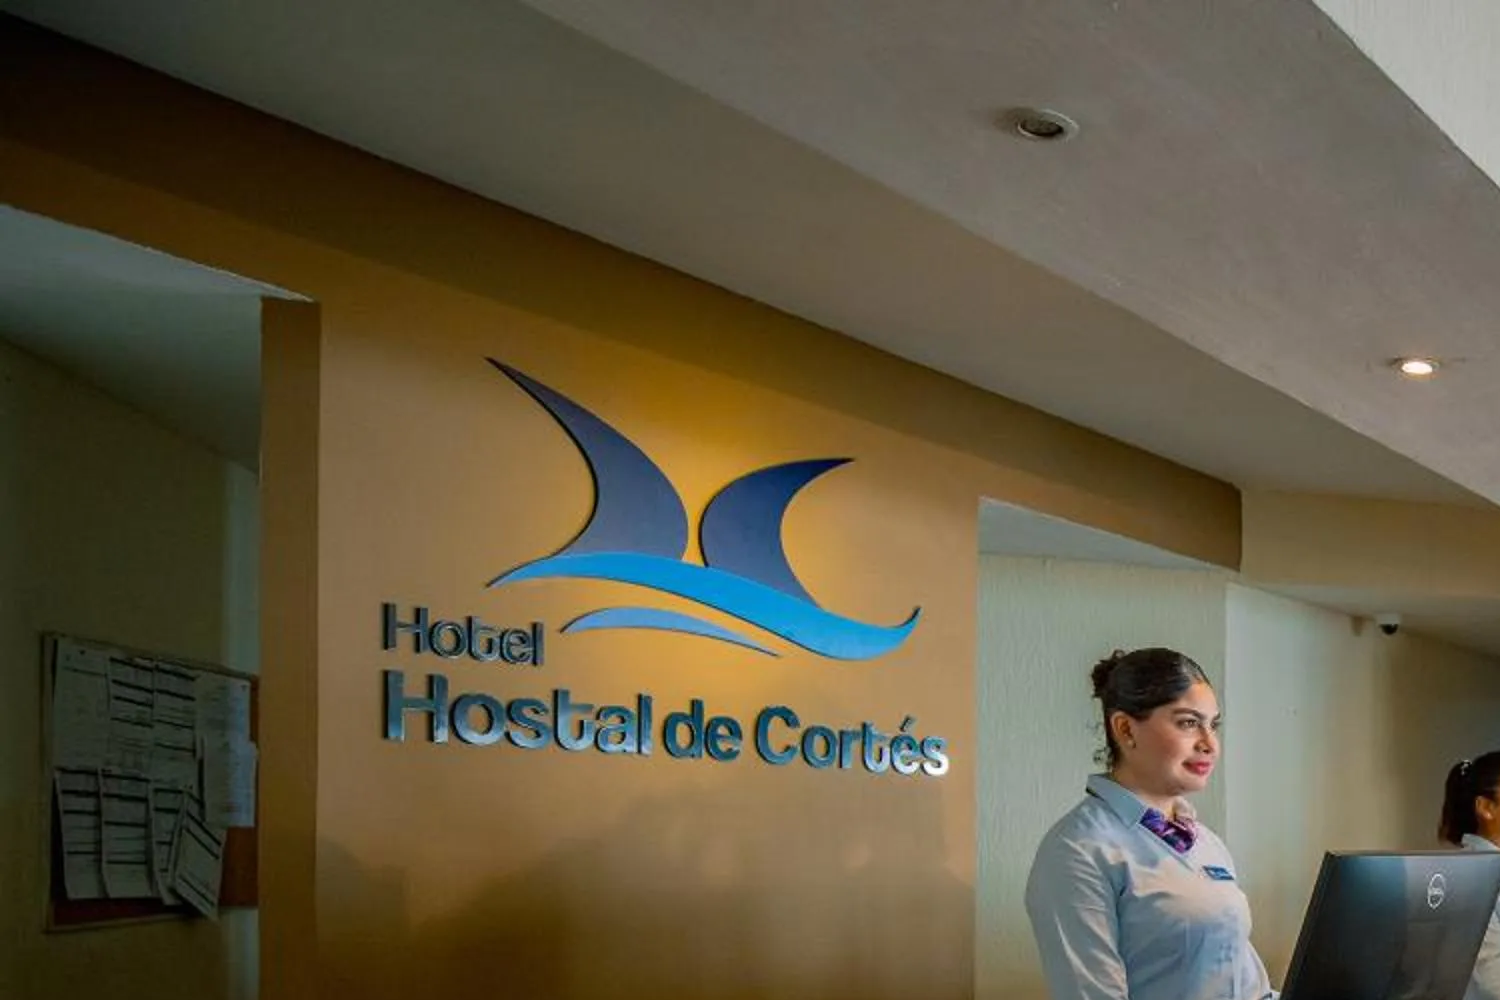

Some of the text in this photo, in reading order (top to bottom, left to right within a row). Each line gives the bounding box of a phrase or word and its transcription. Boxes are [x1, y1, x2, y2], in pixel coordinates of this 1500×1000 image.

[382, 602, 544, 665] Hotel
[382, 670, 950, 777] Hostal de Cortés
